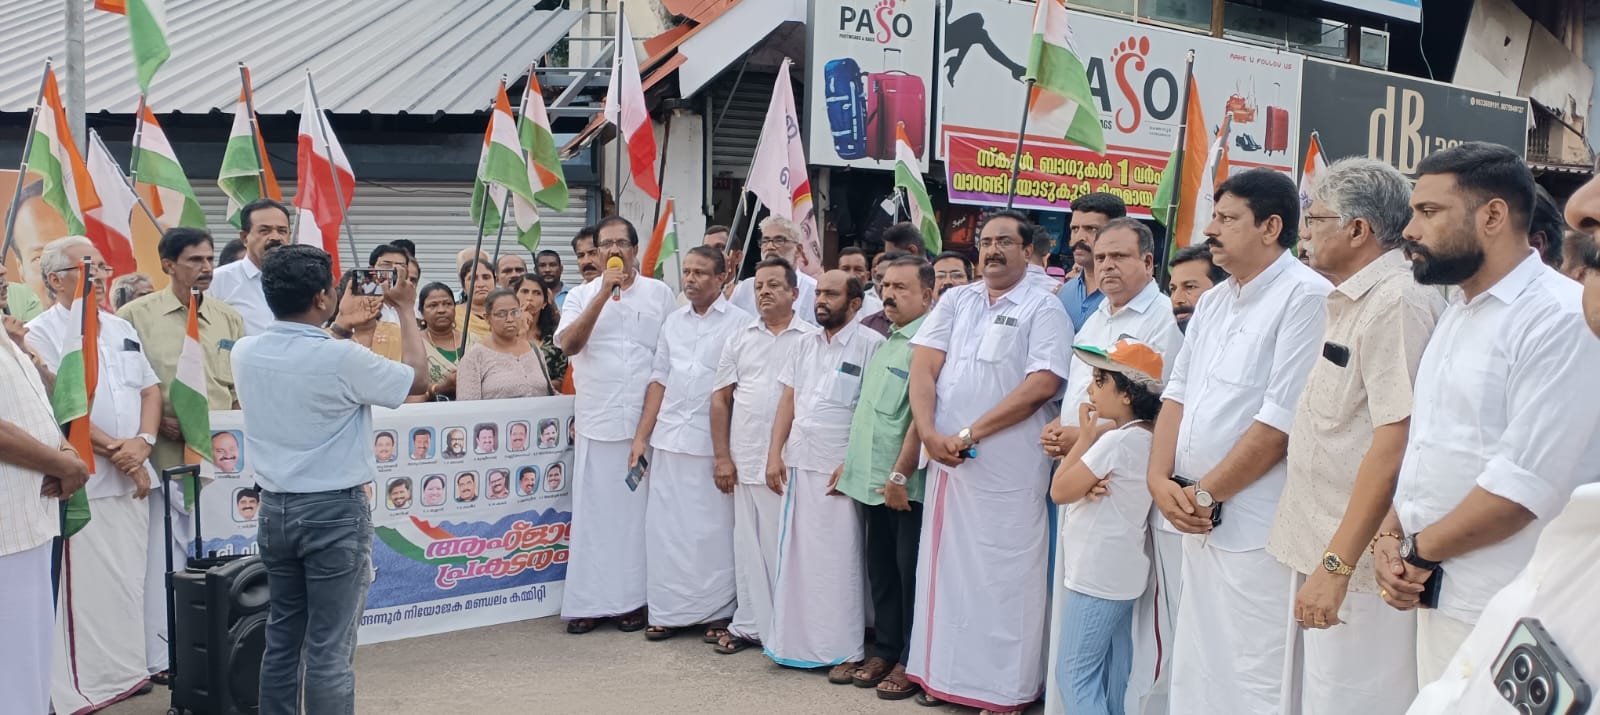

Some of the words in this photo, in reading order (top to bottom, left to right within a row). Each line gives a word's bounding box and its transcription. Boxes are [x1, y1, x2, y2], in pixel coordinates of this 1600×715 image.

[840, 6, 913, 44] PASO
[1086, 52, 1179, 134] ASO
[1039, 155, 1113, 180] ബാഗുകൾ
[1117, 158, 1130, 186] 1
[404, 604, 463, 620] നിയോജക
[465, 598, 508, 611] മണ്ഡലം
[510, 584, 547, 603] കമ്മിറ്റി
